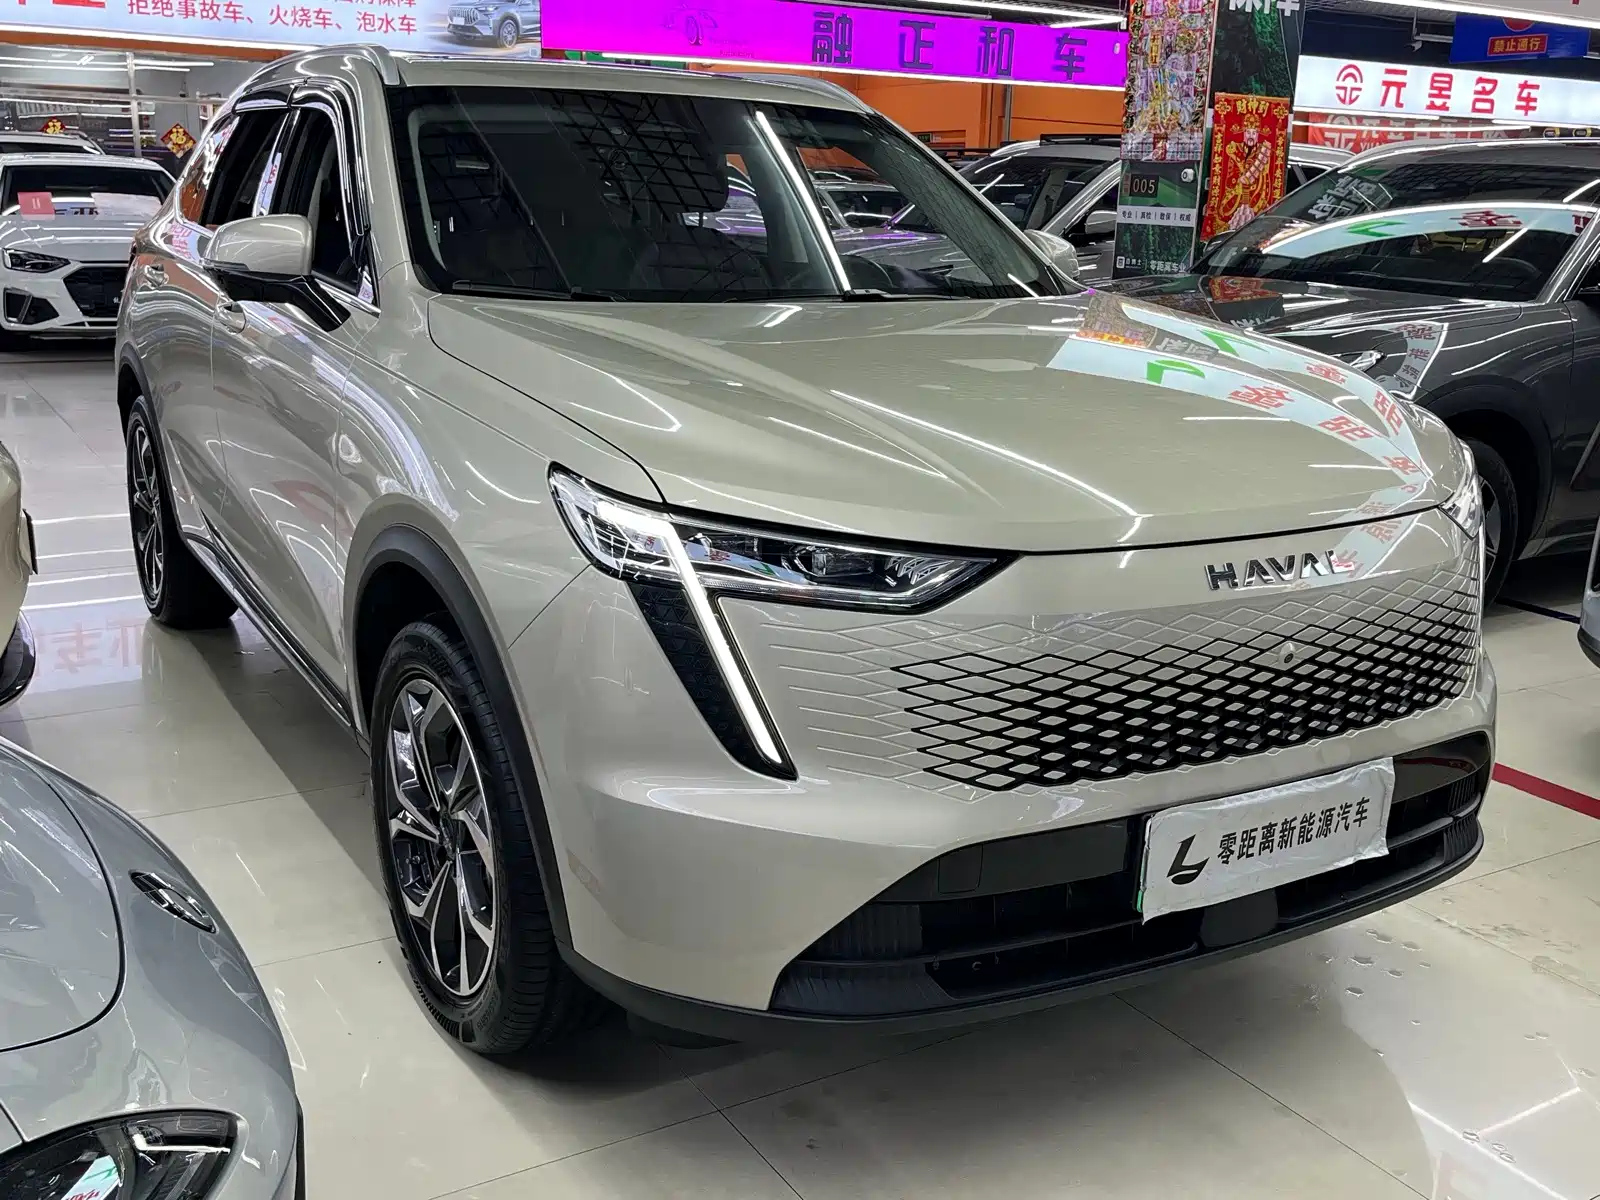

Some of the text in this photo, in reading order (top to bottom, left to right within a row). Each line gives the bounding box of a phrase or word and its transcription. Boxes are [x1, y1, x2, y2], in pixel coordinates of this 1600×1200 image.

[1493, 37, 1541, 53] 禁止通行
[1379, 68, 1540, 117] 元昱名车
[1133, 179, 1156, 194] 005
[1204, 549, 1355, 590] HAVAL
[1217, 797, 1370, 865] 零距离新能源汽车
